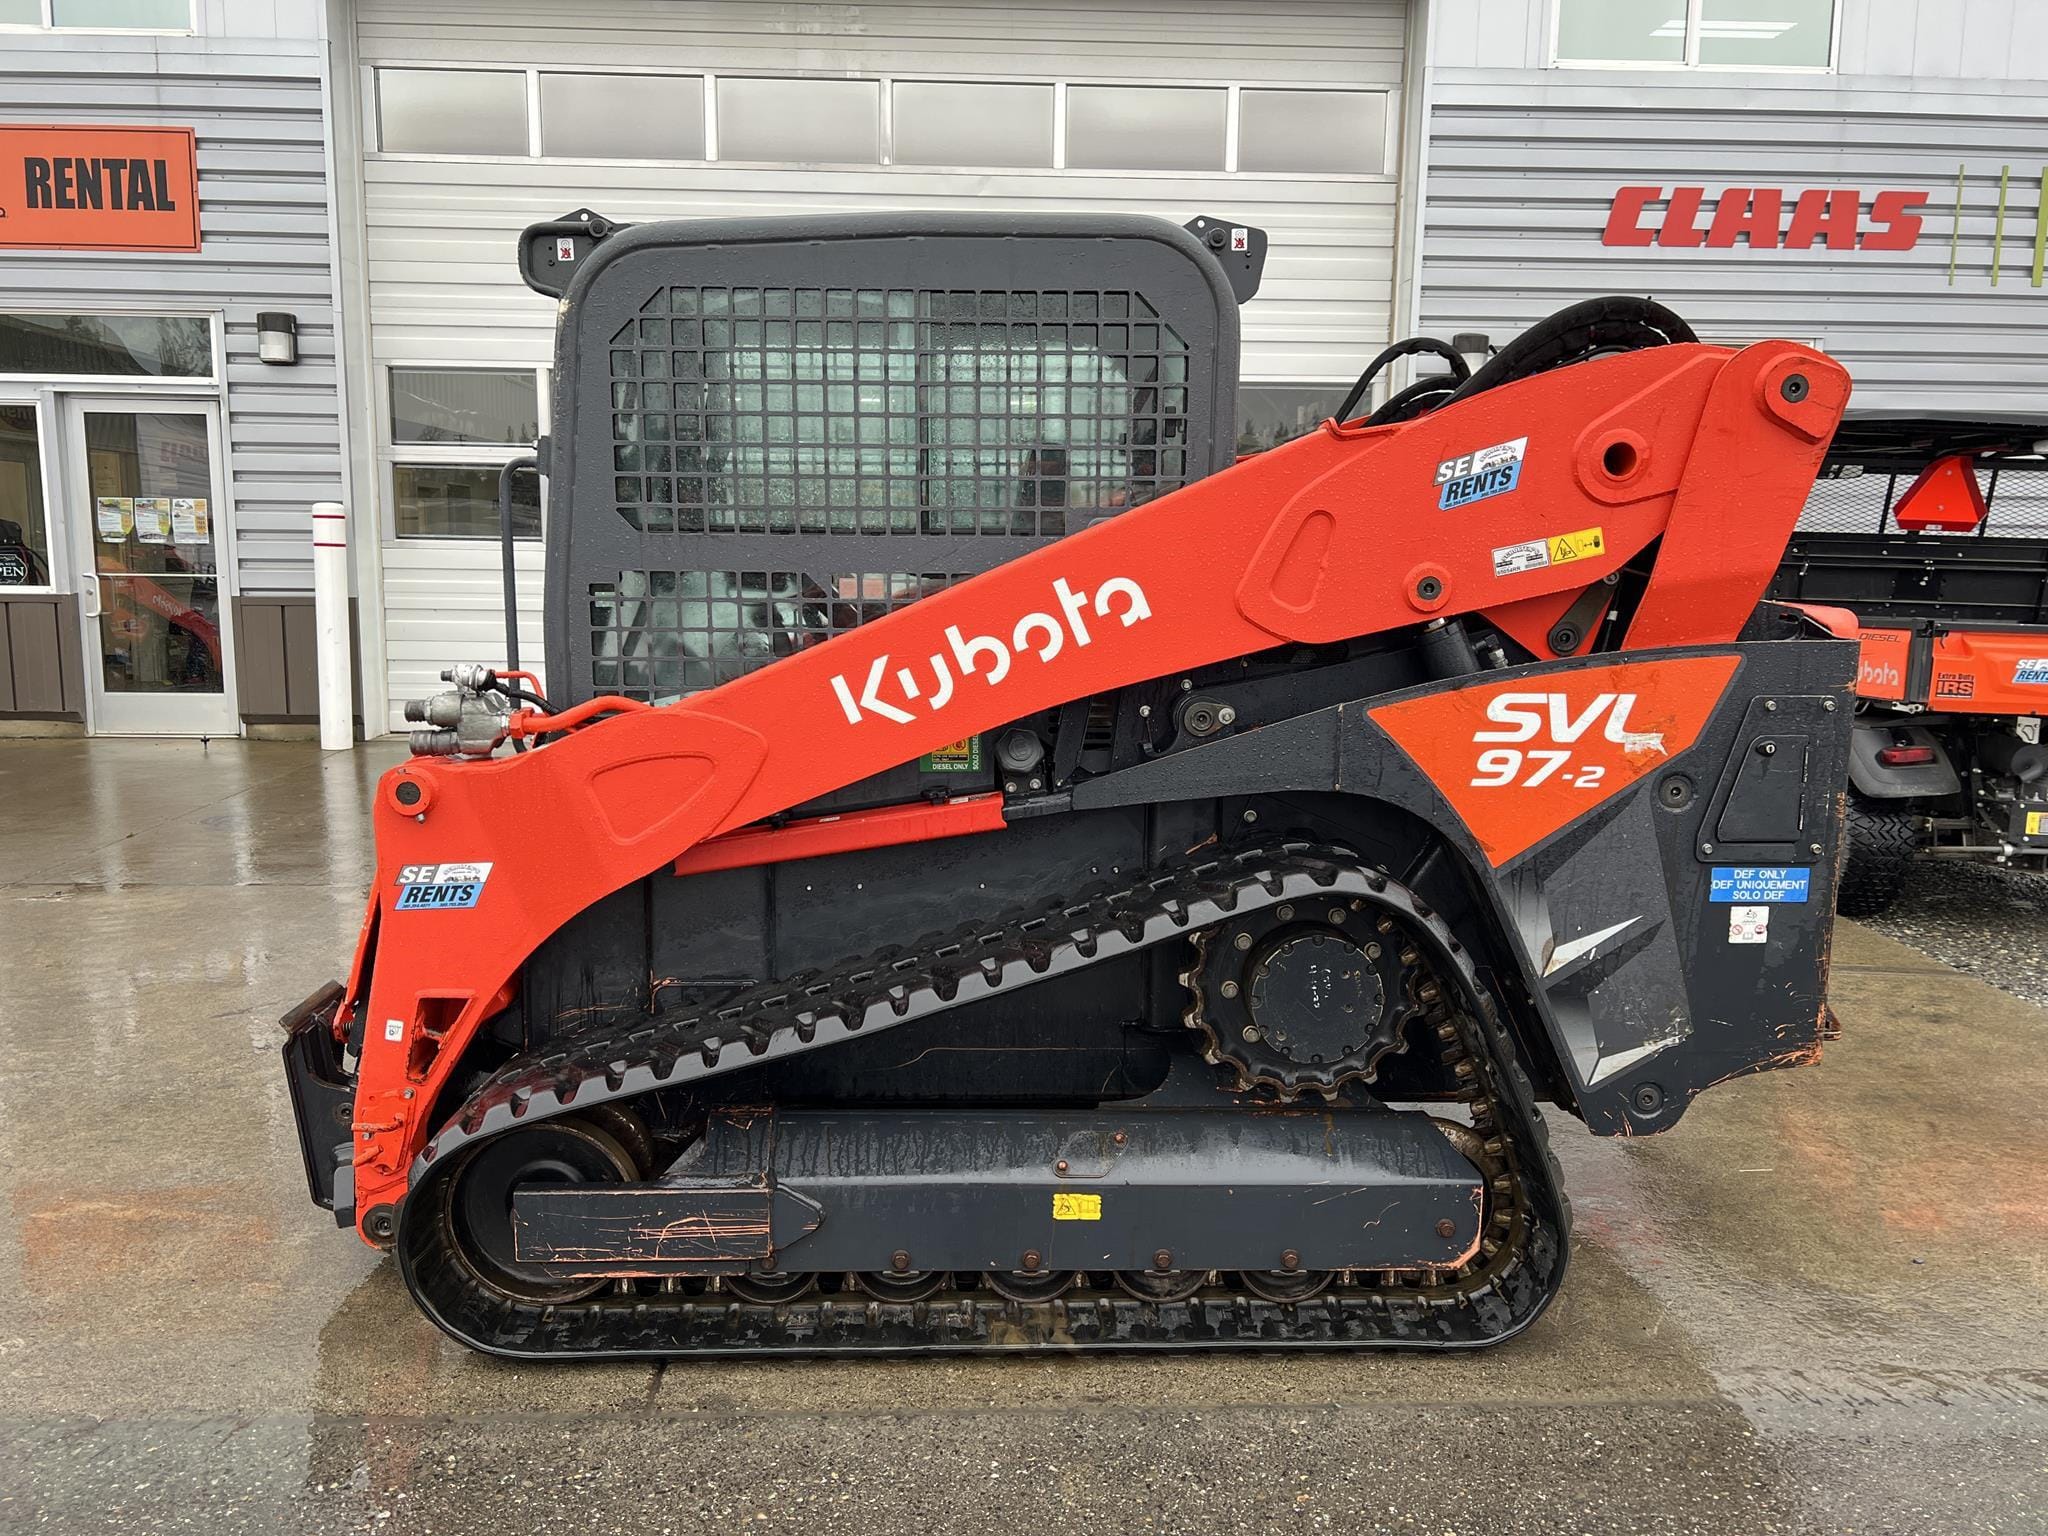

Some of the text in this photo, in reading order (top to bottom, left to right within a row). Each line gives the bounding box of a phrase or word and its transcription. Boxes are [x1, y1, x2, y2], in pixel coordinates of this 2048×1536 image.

[24, 156, 176, 212] RENTAL
[1601, 186, 1930, 252] CLAAS
[1437, 456, 1471, 482] SE
[1445, 465, 1513, 503] RENTS
[1858, 632, 1901, 643] DIESEL
[830, 576, 1152, 725] Kubota
[2015, 658, 2037, 669] SE
[1936, 681, 1973, 694] IRS
[1472, 692, 1666, 745] SVL
[1469, 749, 1606, 788] 97-2
[400, 866, 435, 884] SE
[1734, 869, 1787, 879] DEF ONLY
[404, 884, 475, 904] RENTS
[1712, 880, 1807, 890] DEF UNIQUEMENT
[1732, 890, 1786, 900] SOLO DEF
